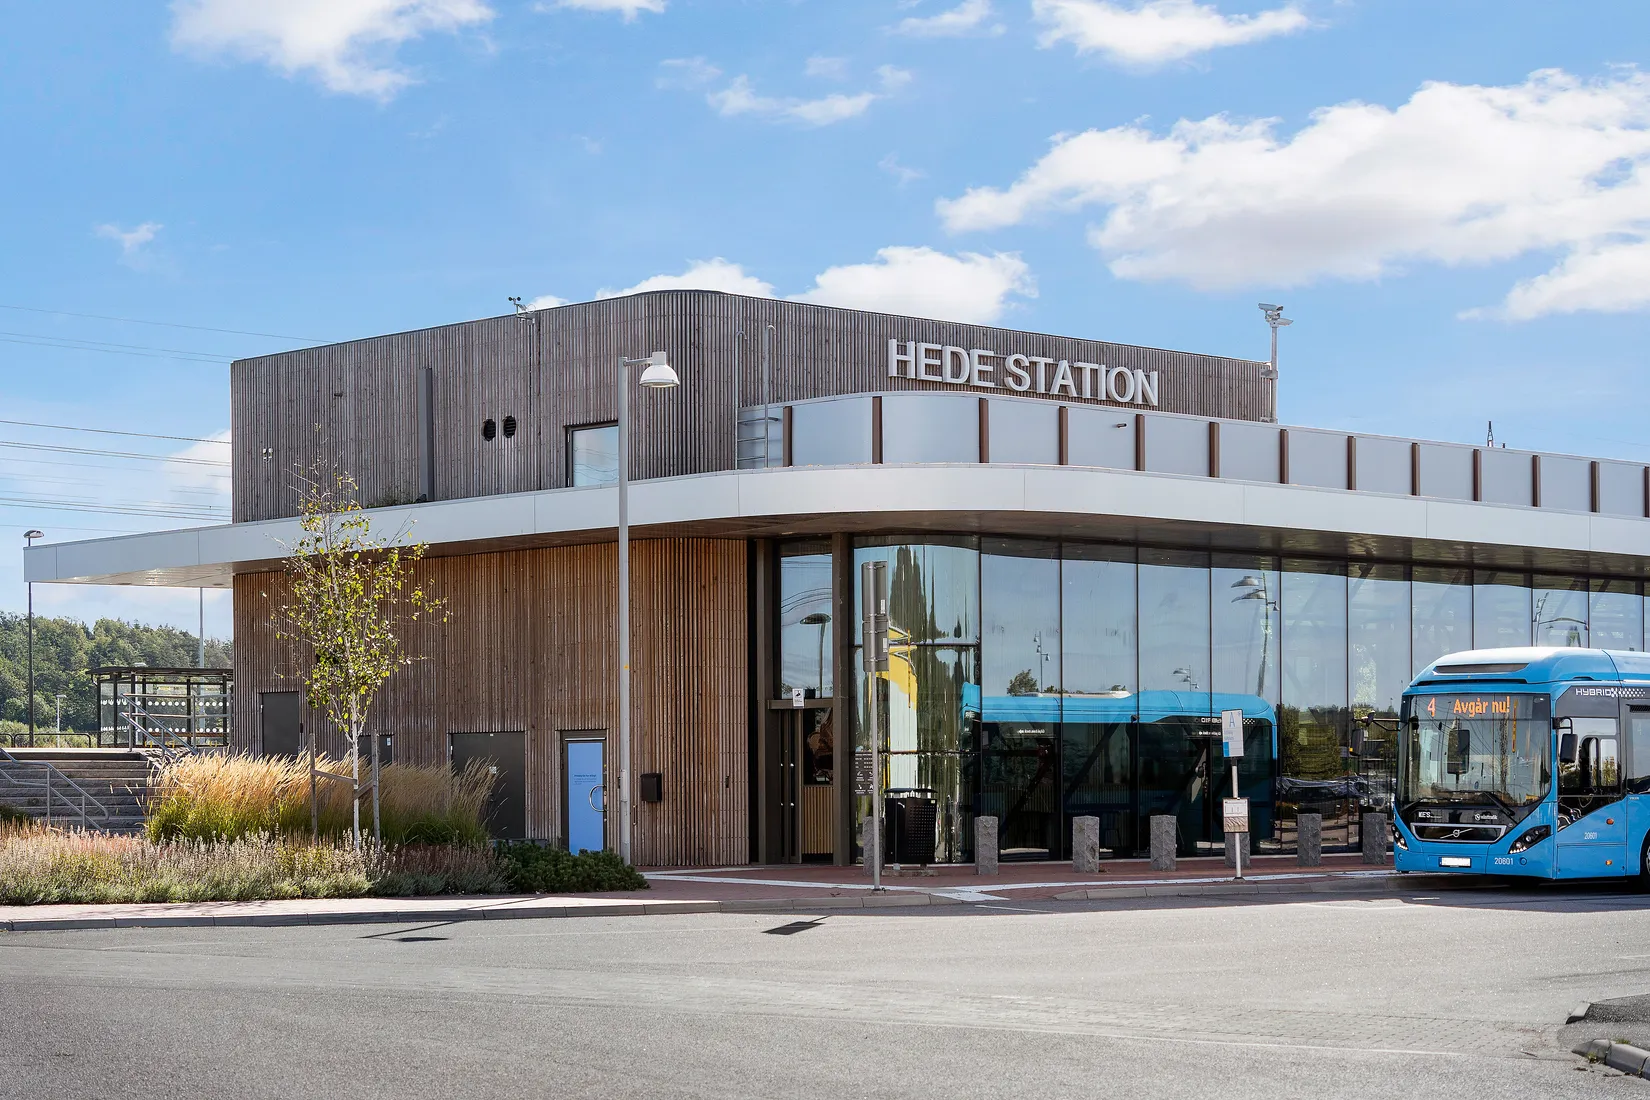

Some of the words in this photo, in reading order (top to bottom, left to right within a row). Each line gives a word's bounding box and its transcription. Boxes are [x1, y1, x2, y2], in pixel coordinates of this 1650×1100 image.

[888, 339, 995, 387] HEDE
[1004, 354, 1158, 406] STATION
[1575, 688, 1612, 696] HYBRID
[1427, 697, 1436, 717] 4
[1453, 697, 1489, 718] Avgår
[1491, 696, 1510, 713] nu!
[1229, 712, 1236, 728] A
